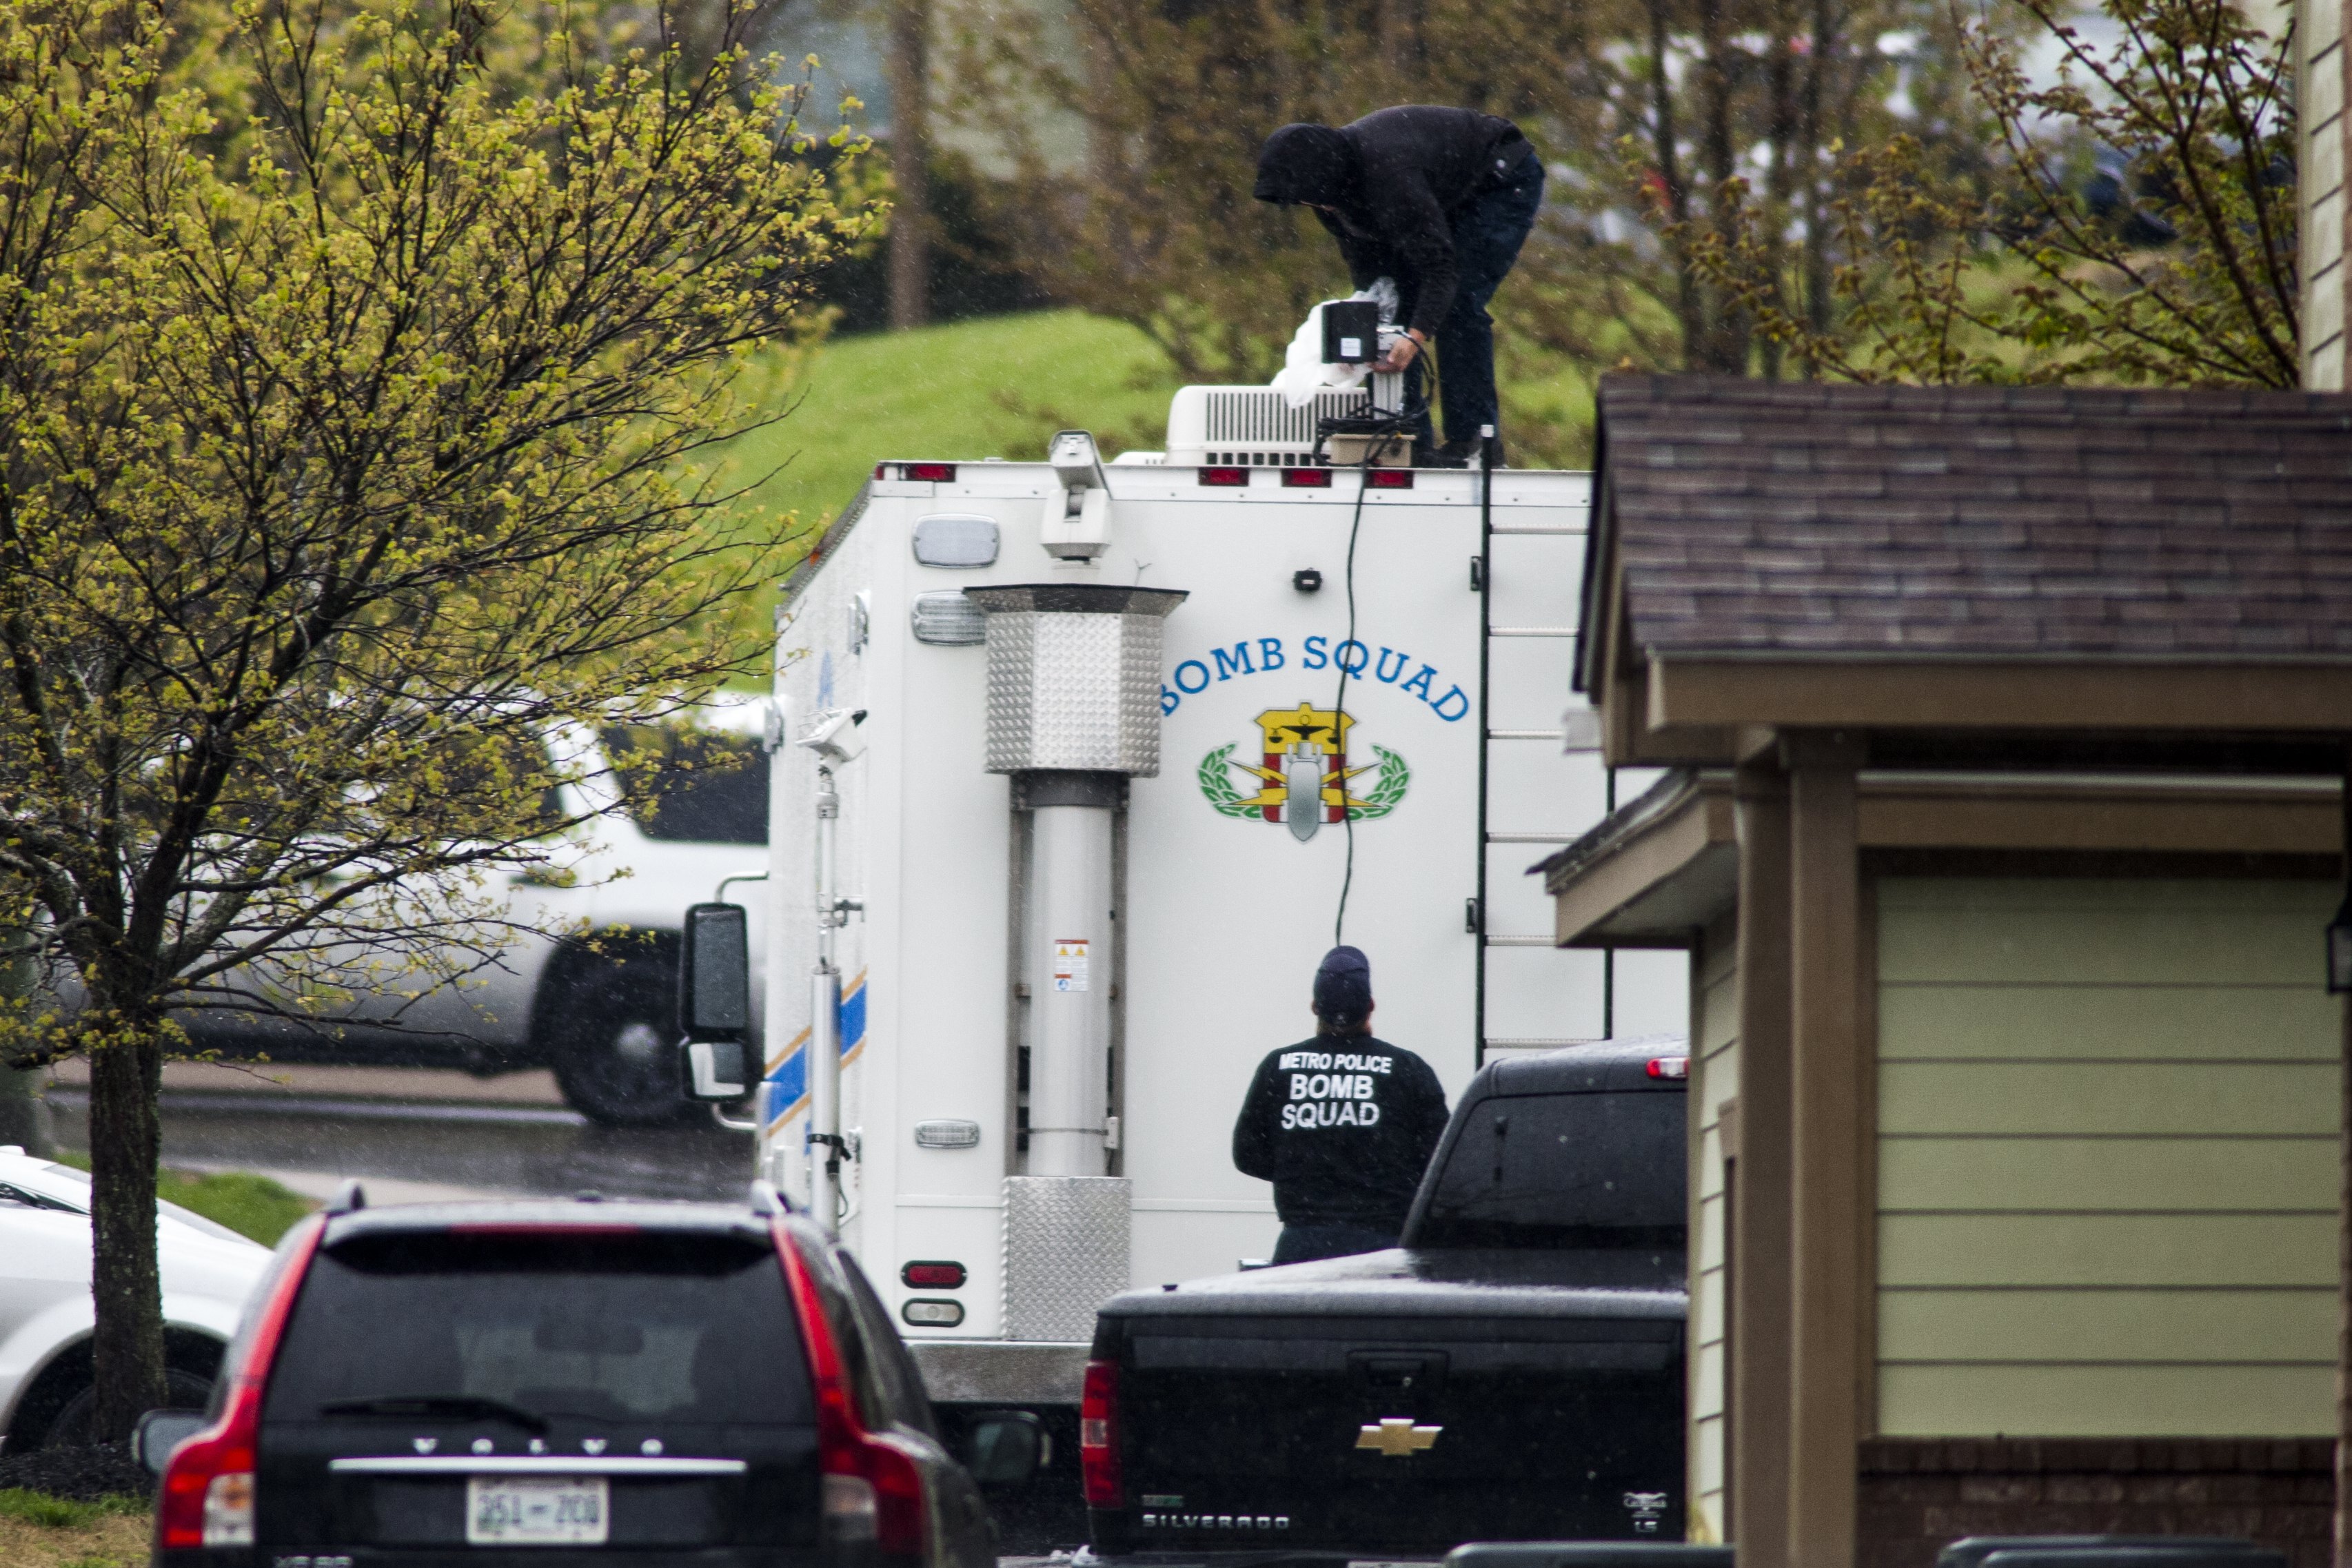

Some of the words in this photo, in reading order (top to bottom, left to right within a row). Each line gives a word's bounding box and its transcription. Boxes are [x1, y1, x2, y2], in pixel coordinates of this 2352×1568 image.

[1302, 635, 1470, 723] SQUAD
[1278, 1052, 1332, 1070] METRO
[1334, 1053, 1392, 1074] POLICE
[1290, 1073, 1374, 1100] BOMB
[1281, 1101, 1380, 1130] SQUAD
[1142, 1513, 1290, 1529] SILVERADO
